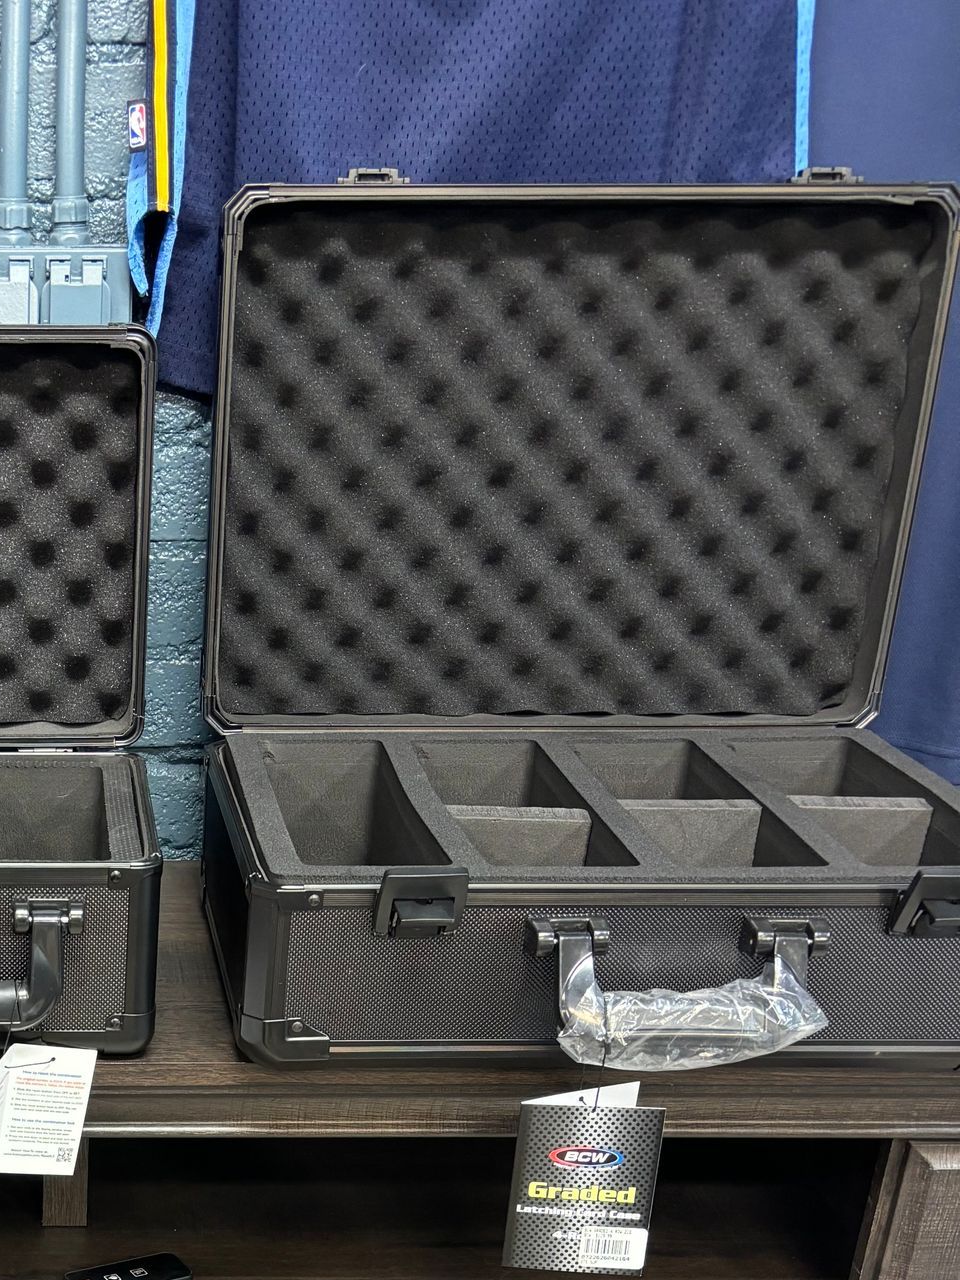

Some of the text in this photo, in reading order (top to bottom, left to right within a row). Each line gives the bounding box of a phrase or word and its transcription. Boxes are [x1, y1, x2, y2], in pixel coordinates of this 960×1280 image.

[564, 1151, 610, 1163] BCW
[528, 1181, 637, 1204] Graded
[516, 1204, 641, 1220] Latching Card Case
